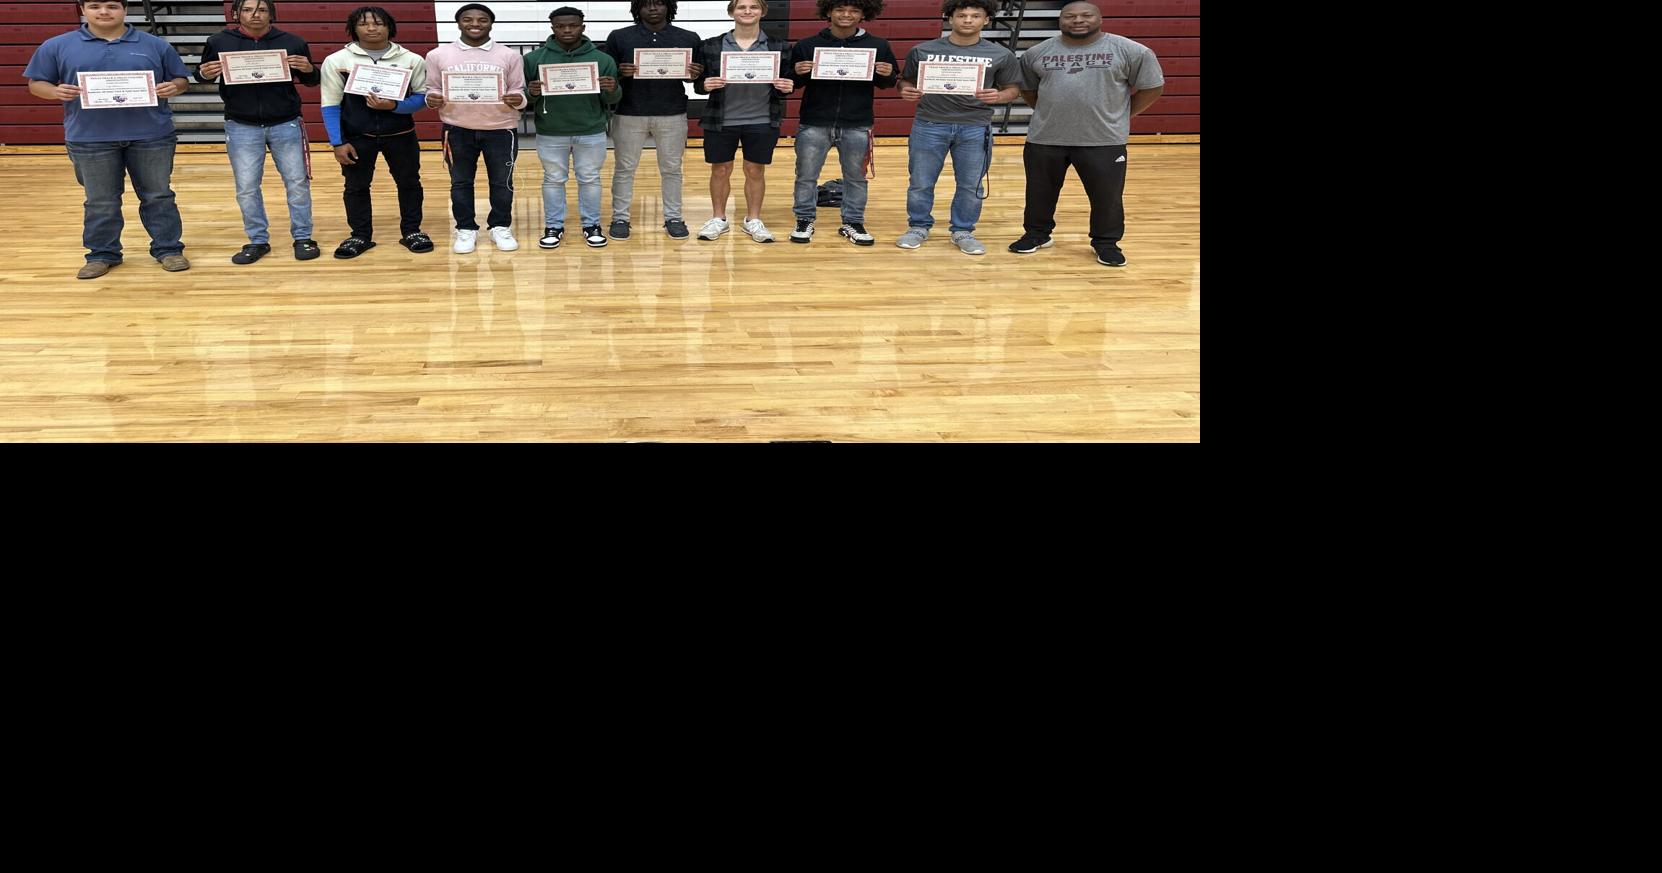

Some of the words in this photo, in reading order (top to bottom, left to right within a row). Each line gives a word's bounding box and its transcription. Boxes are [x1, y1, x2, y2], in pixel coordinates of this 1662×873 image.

[927, 54, 992, 67] PALESTINE
[1042, 53, 1114, 63] PALESTINE
[1042, 60, 1111, 68] TRACK
